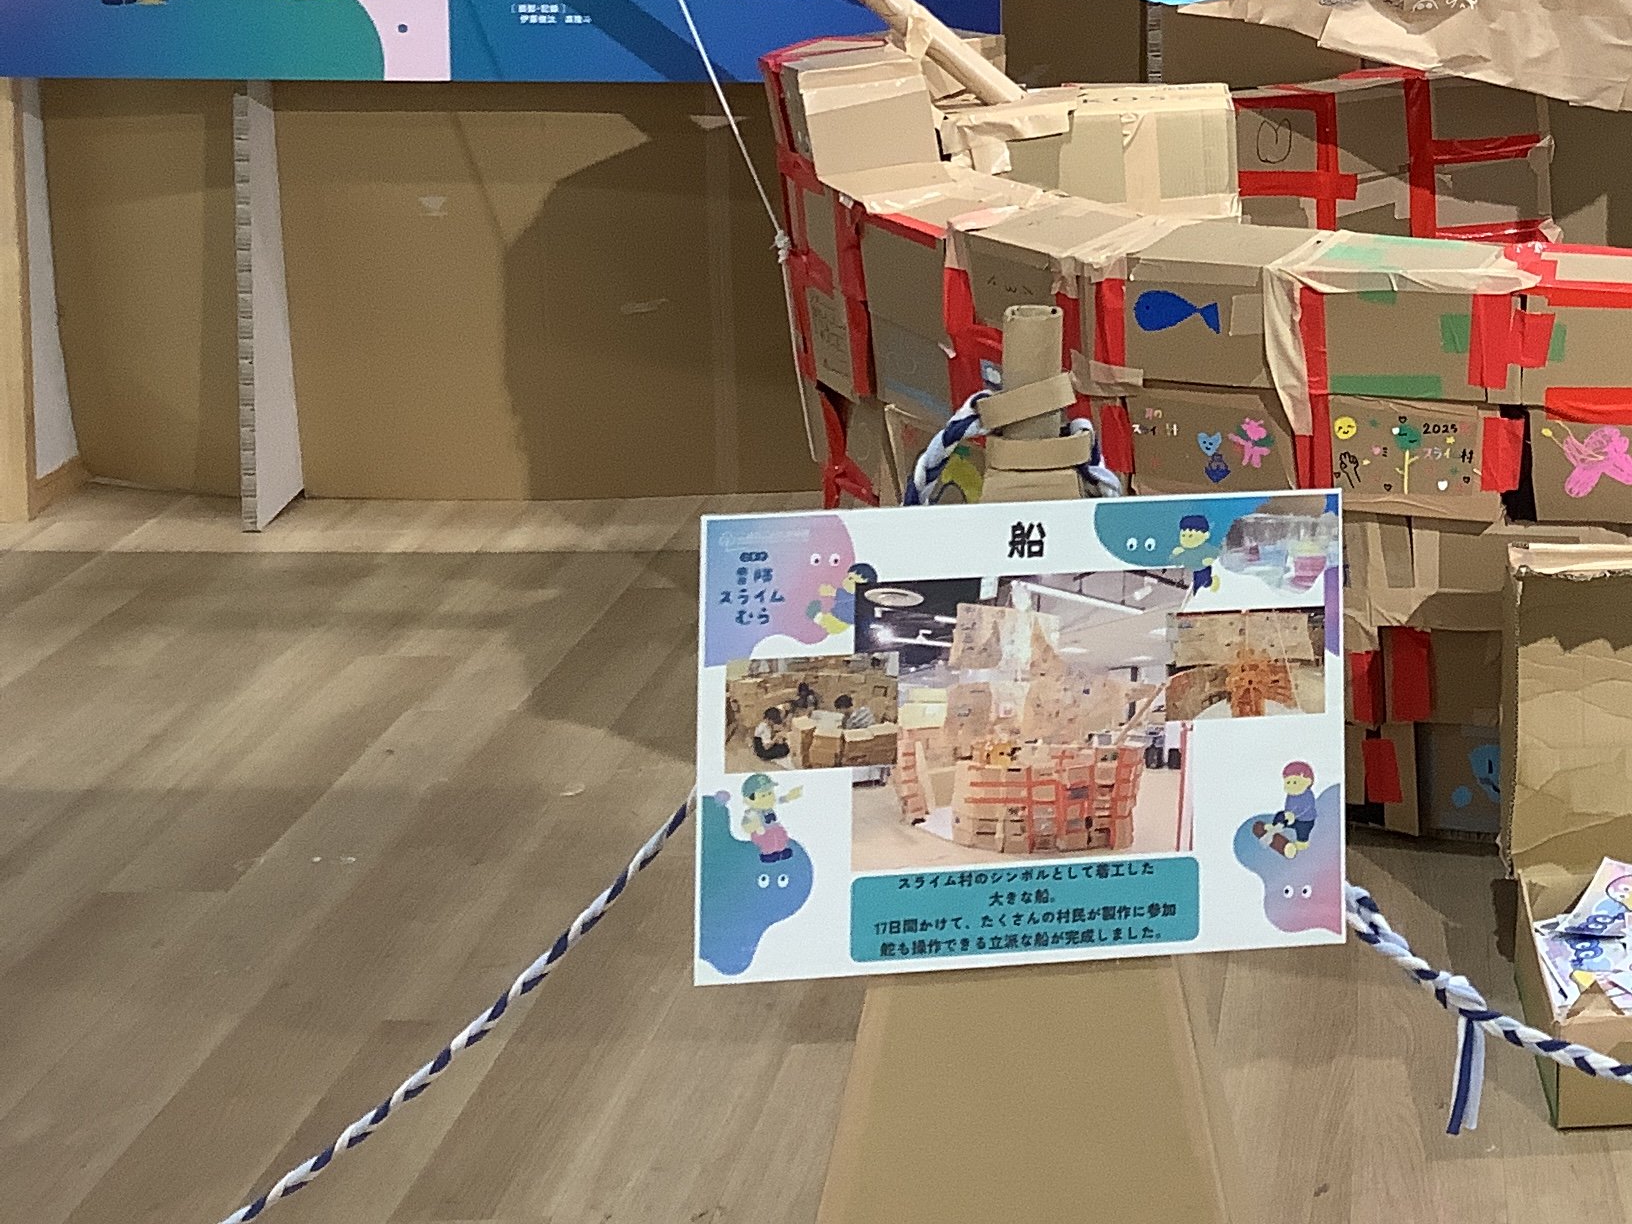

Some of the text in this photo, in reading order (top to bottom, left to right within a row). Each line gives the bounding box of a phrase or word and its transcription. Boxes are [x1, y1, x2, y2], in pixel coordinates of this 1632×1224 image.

[1422, 423, 1458, 435] 2025
[1007, 520, 1047, 559] 船
[719, 587, 786, 606] スライム
[734, 607, 771, 625] むら
[898, 861, 1155, 891] スライム村のシンボルとして着工した
[988, 887, 1057, 907] 大きな船。
[879, 926, 1164, 957] 舵も操作できる立派な船が完成しました。
